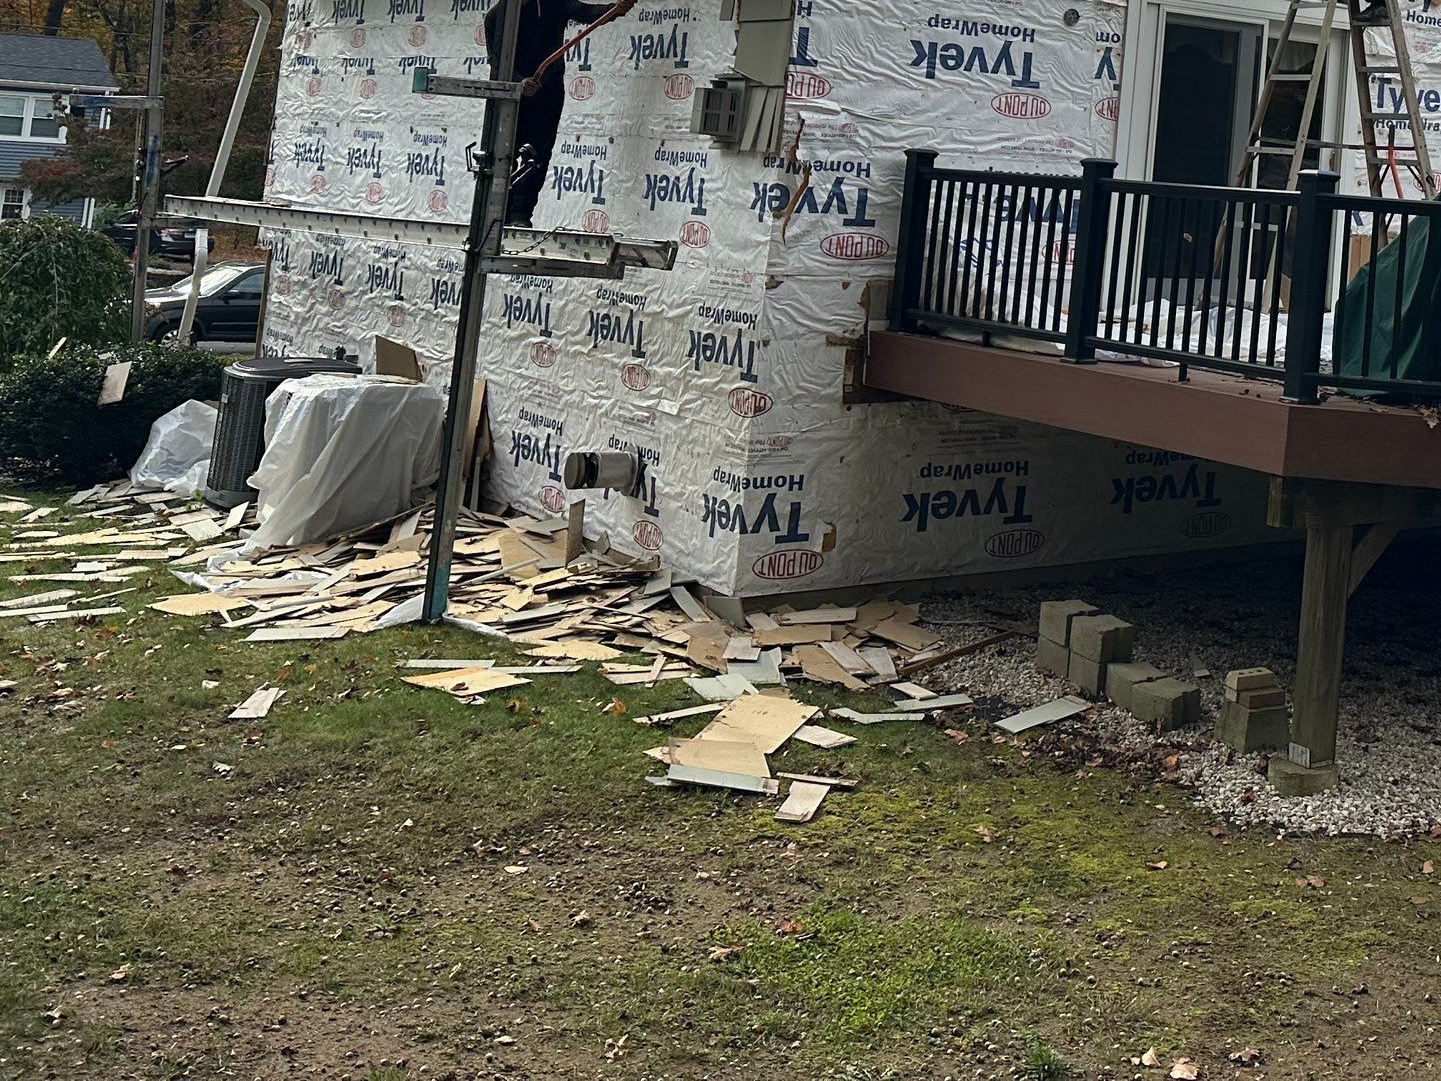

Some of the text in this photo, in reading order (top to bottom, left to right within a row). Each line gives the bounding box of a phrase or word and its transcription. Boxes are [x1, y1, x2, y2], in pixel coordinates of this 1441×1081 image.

[638, 7, 690, 25] HomeWrap
[927, 13, 1036, 43] HomeWrap
[629, 23, 689, 70] Tyvek
[910, 39, 1040, 89] Tyvek
[346, 142, 382, 178] Tyvek
[407, 147, 445, 186] Tyvek
[560, 140, 607, 160] HomeWrap
[654, 146, 708, 168] HomeWrap
[550, 159, 606, 205] Tyvek
[643, 167, 707, 216] Tyvek
[750, 177, 876, 228] Tyvek
[310, 249, 345, 286] Tyvek
[368, 261, 405, 301] Tyvek
[502, 292, 553, 338] Tyvek
[596, 285, 647, 310] HomeWrap
[698, 303, 758, 330] HomeWrap
[586, 309, 647, 359] Tyvek
[688, 328, 759, 383] Tyvek
[518, 406, 563, 437] HomeWrap
[509, 429, 562, 483] Tyvek
[919, 460, 1029, 482] HomeWrap
[713, 466, 804, 492] HomeWrap
[1110, 463, 1222, 514] Tyvek
[701, 493, 809, 544] Tyvek
[902, 478, 1033, 532] Tyvek
